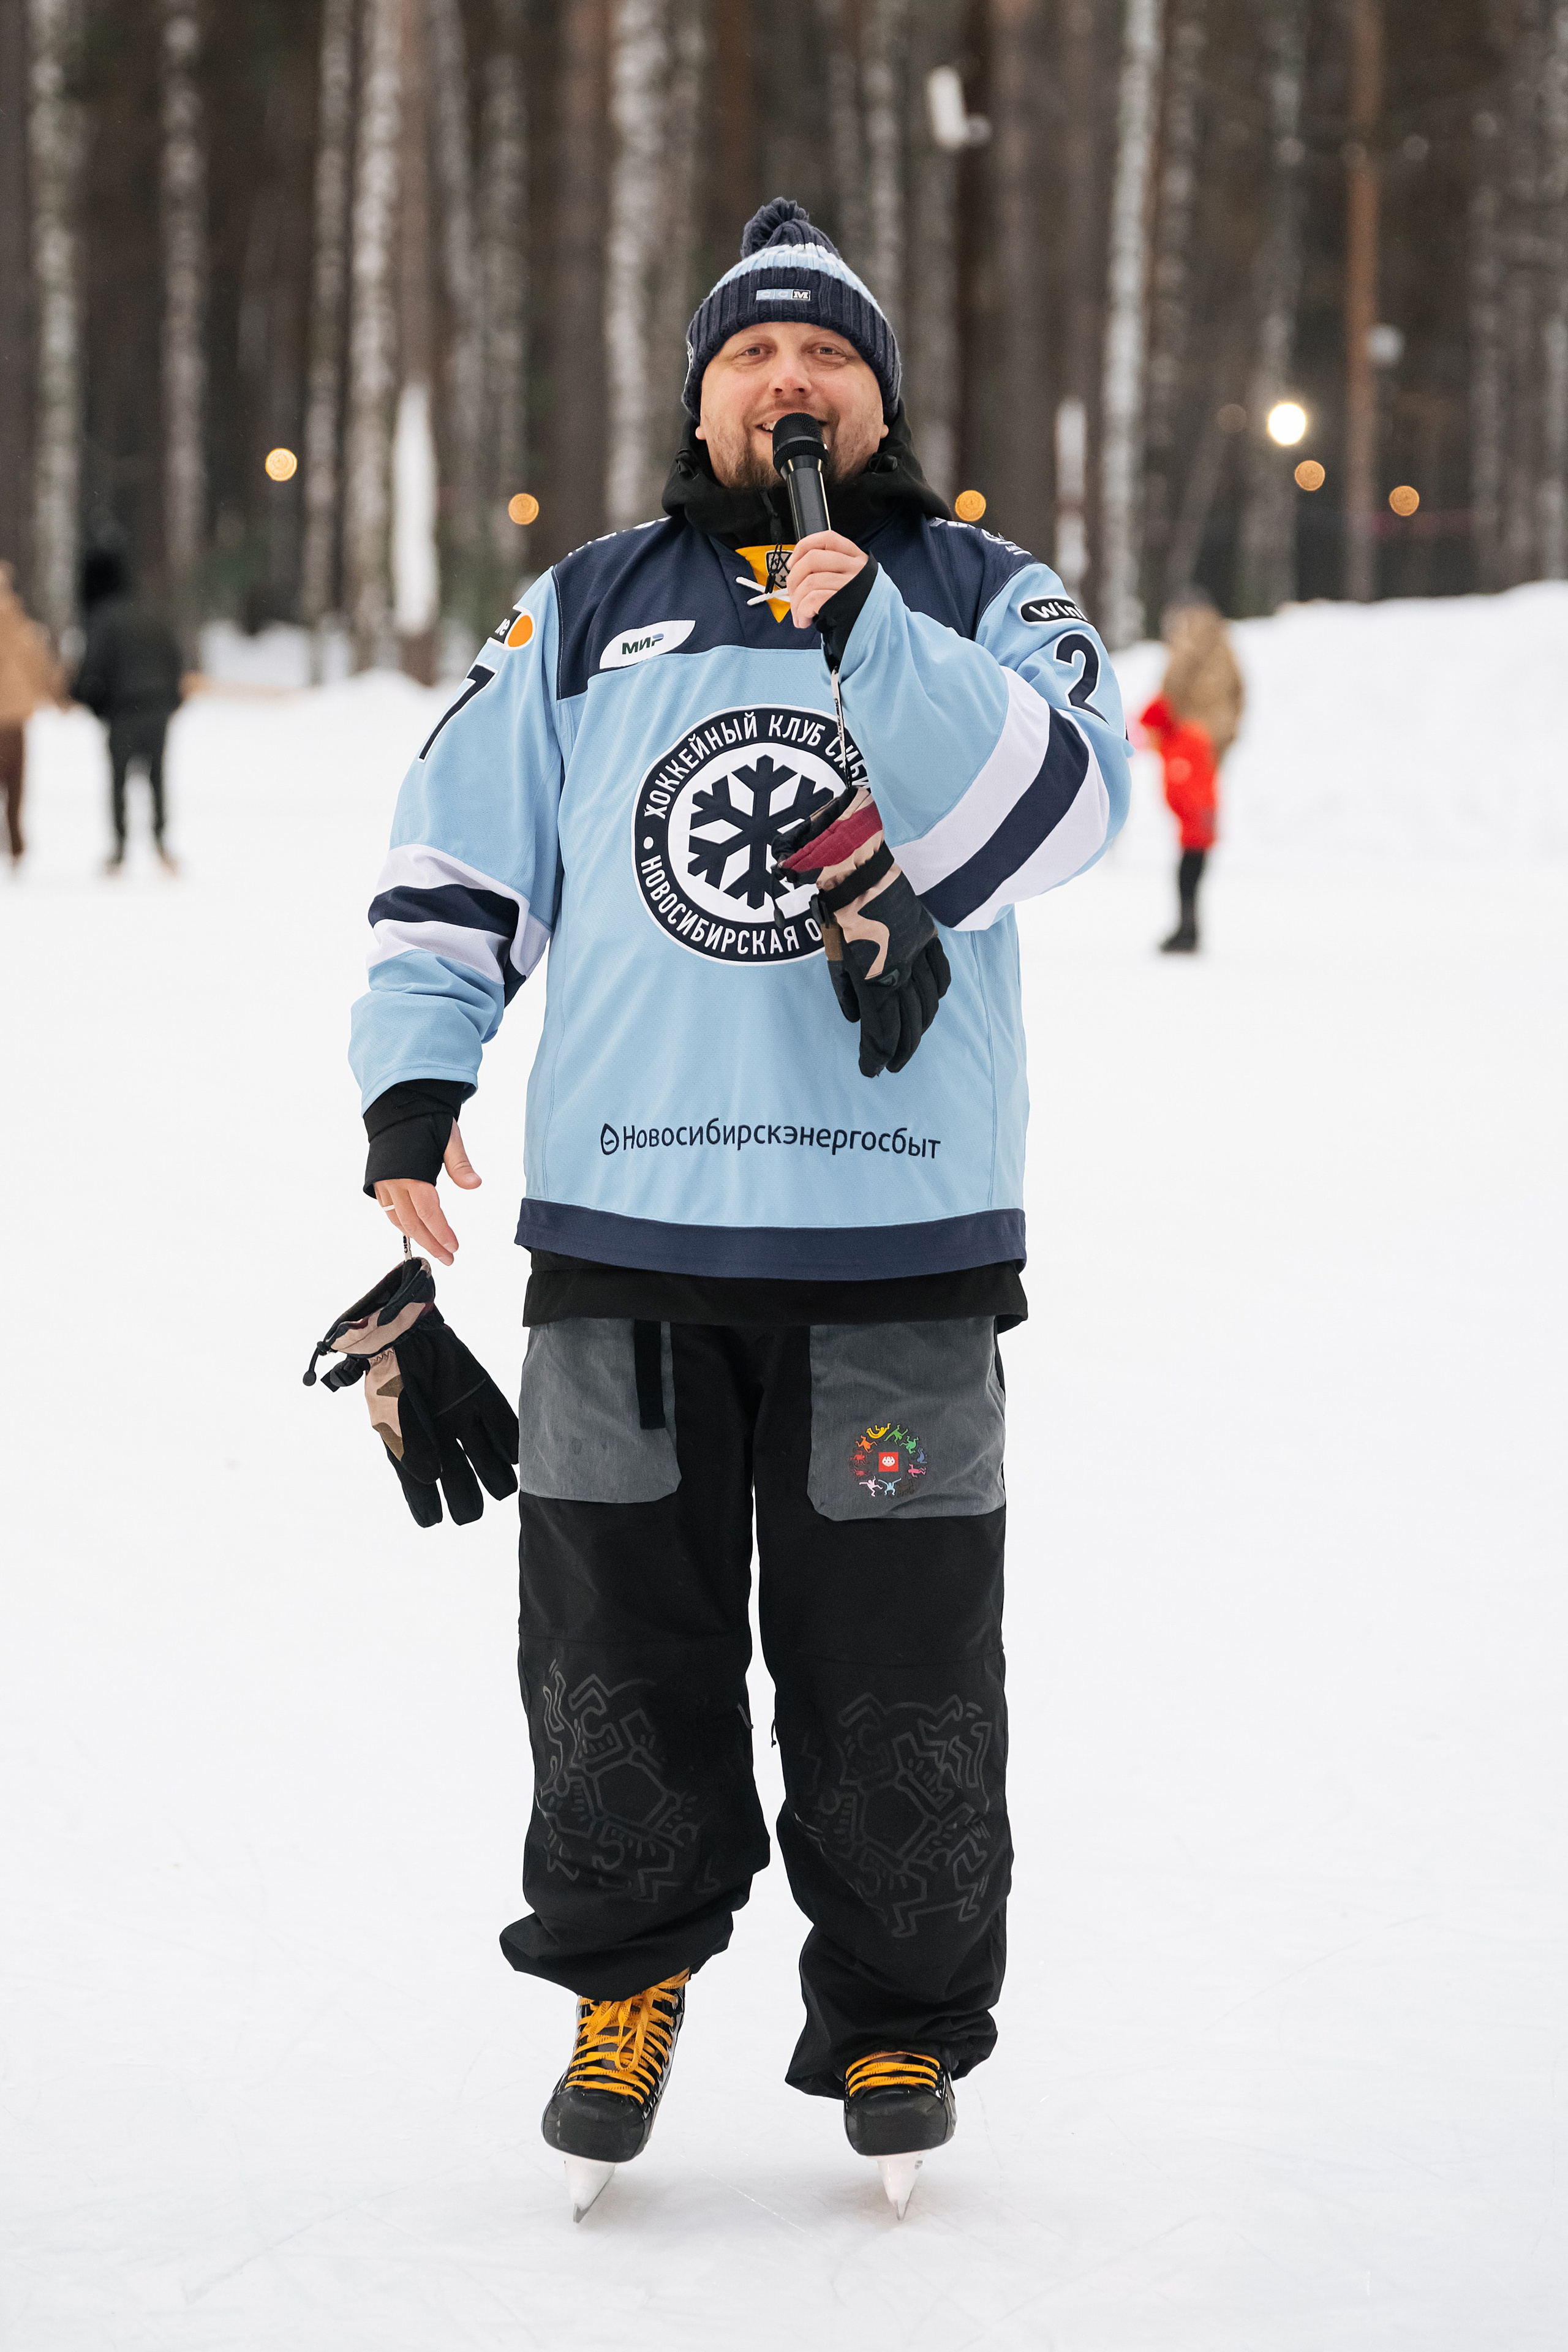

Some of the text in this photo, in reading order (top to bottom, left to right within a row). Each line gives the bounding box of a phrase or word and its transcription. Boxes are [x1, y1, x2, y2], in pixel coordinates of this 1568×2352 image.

[761, 290, 809, 300] CCM
[622, 633, 665, 655] МИР
[1054, 631, 1110, 728] 2
[417, 662, 498, 763] 7
[644, 711, 758, 820] ХОККЕЙНЫЙ
[768, 714, 826, 747] КЛУБ
[641, 854, 801, 956] НОВОСИБИРСКАЯ
[622, 1117, 941, 1159] Новосибирскэнергосбыт
